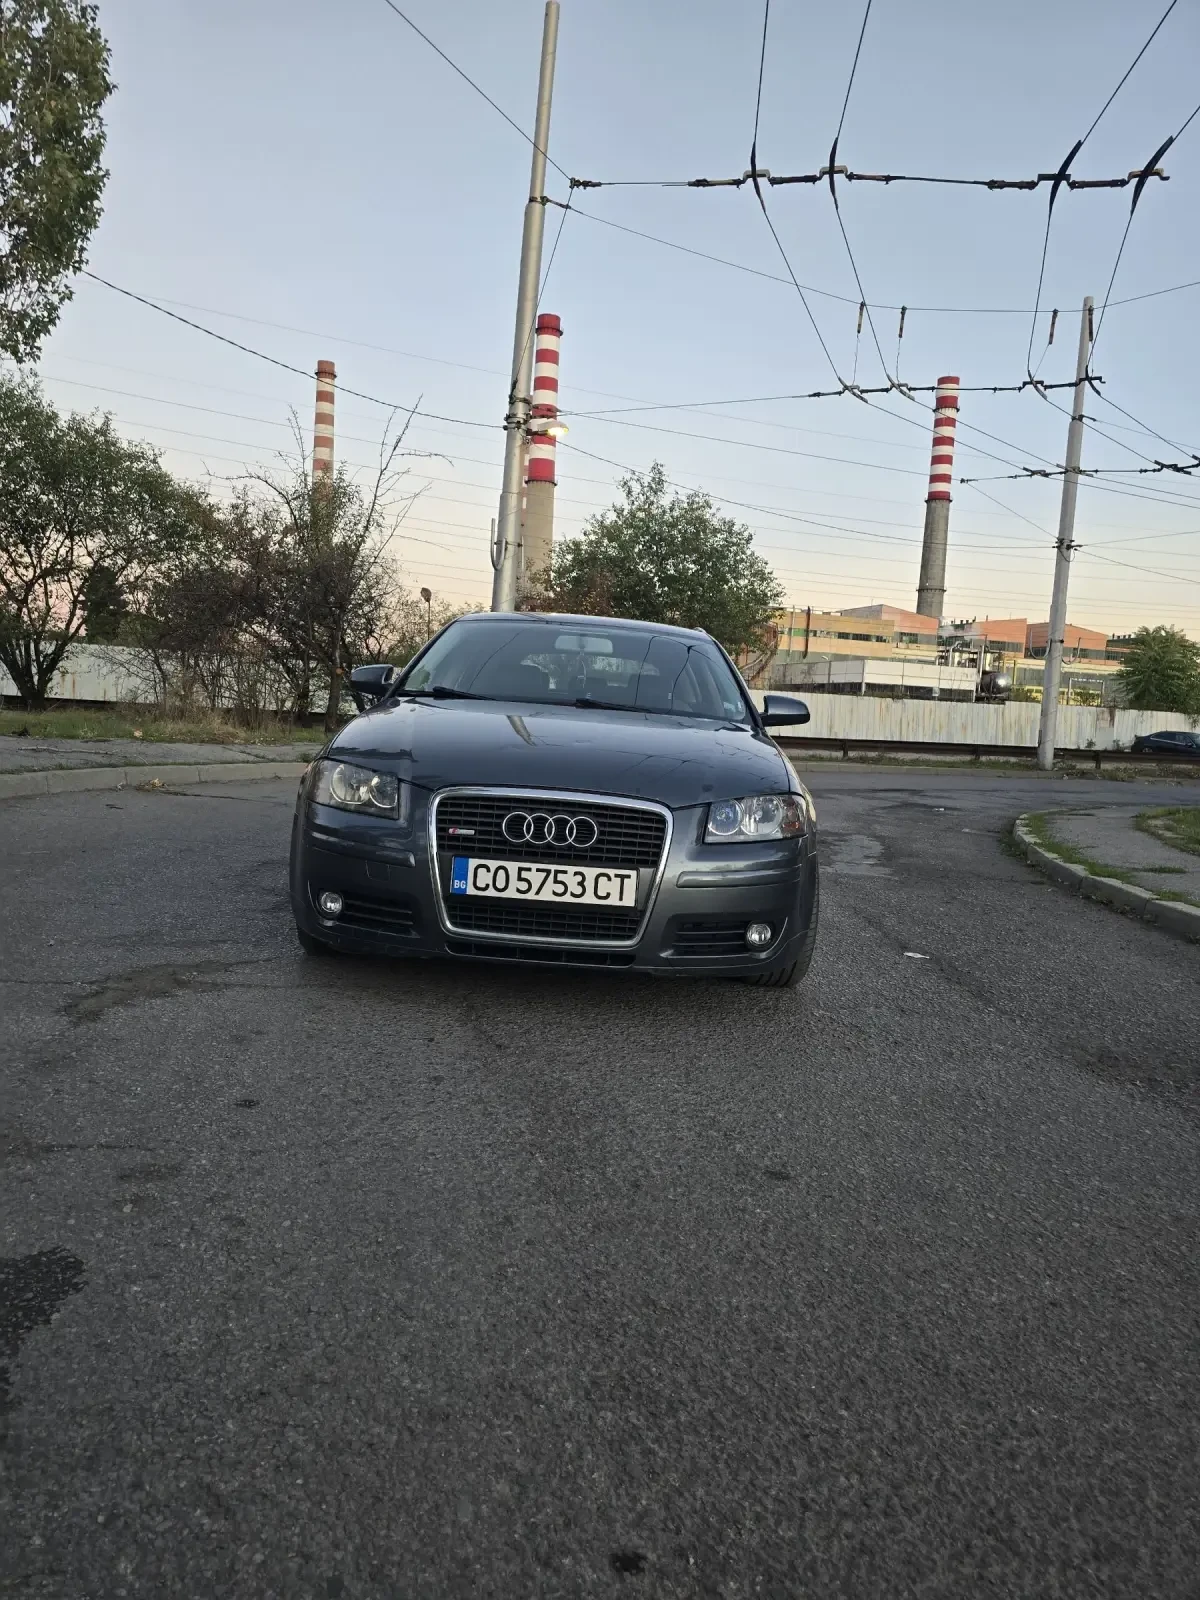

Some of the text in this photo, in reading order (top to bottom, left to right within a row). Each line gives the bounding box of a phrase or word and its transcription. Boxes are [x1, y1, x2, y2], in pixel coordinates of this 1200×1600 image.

[454, 879, 466, 889] BG
[472, 863, 632, 902] CO 5753 CT
